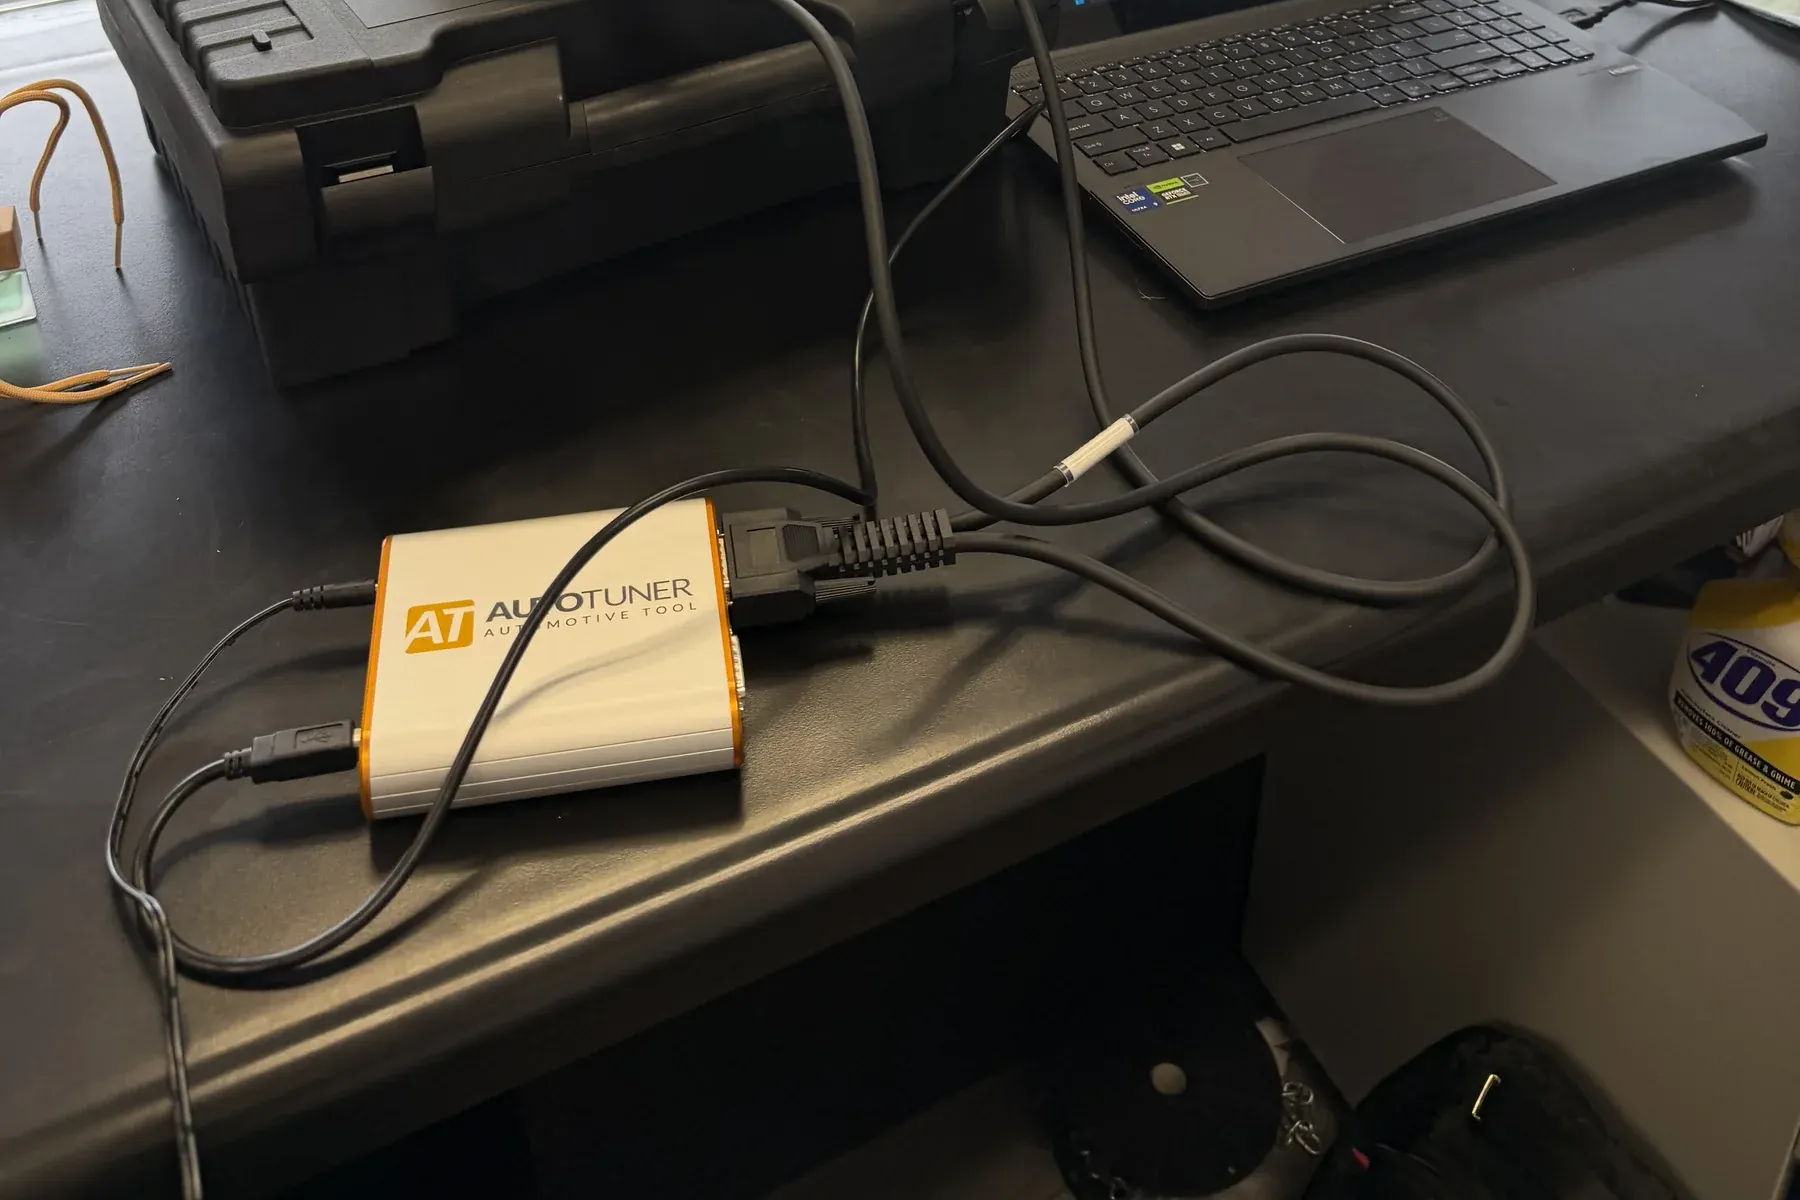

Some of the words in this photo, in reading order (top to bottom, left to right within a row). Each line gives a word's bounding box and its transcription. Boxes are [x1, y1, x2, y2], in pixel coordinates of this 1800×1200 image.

[484, 609, 630, 638] AUTMOTIVE
[642, 602, 698, 616] TOOL
[485, 577, 693, 623] AUOTUNER
[405, 605, 475, 644] AT
[1690, 641, 1800, 728] 409
[1734, 745, 1761, 767] GREASE
[1762, 764, 1769, 774] &
[1770, 770, 1796, 791] GRIME
